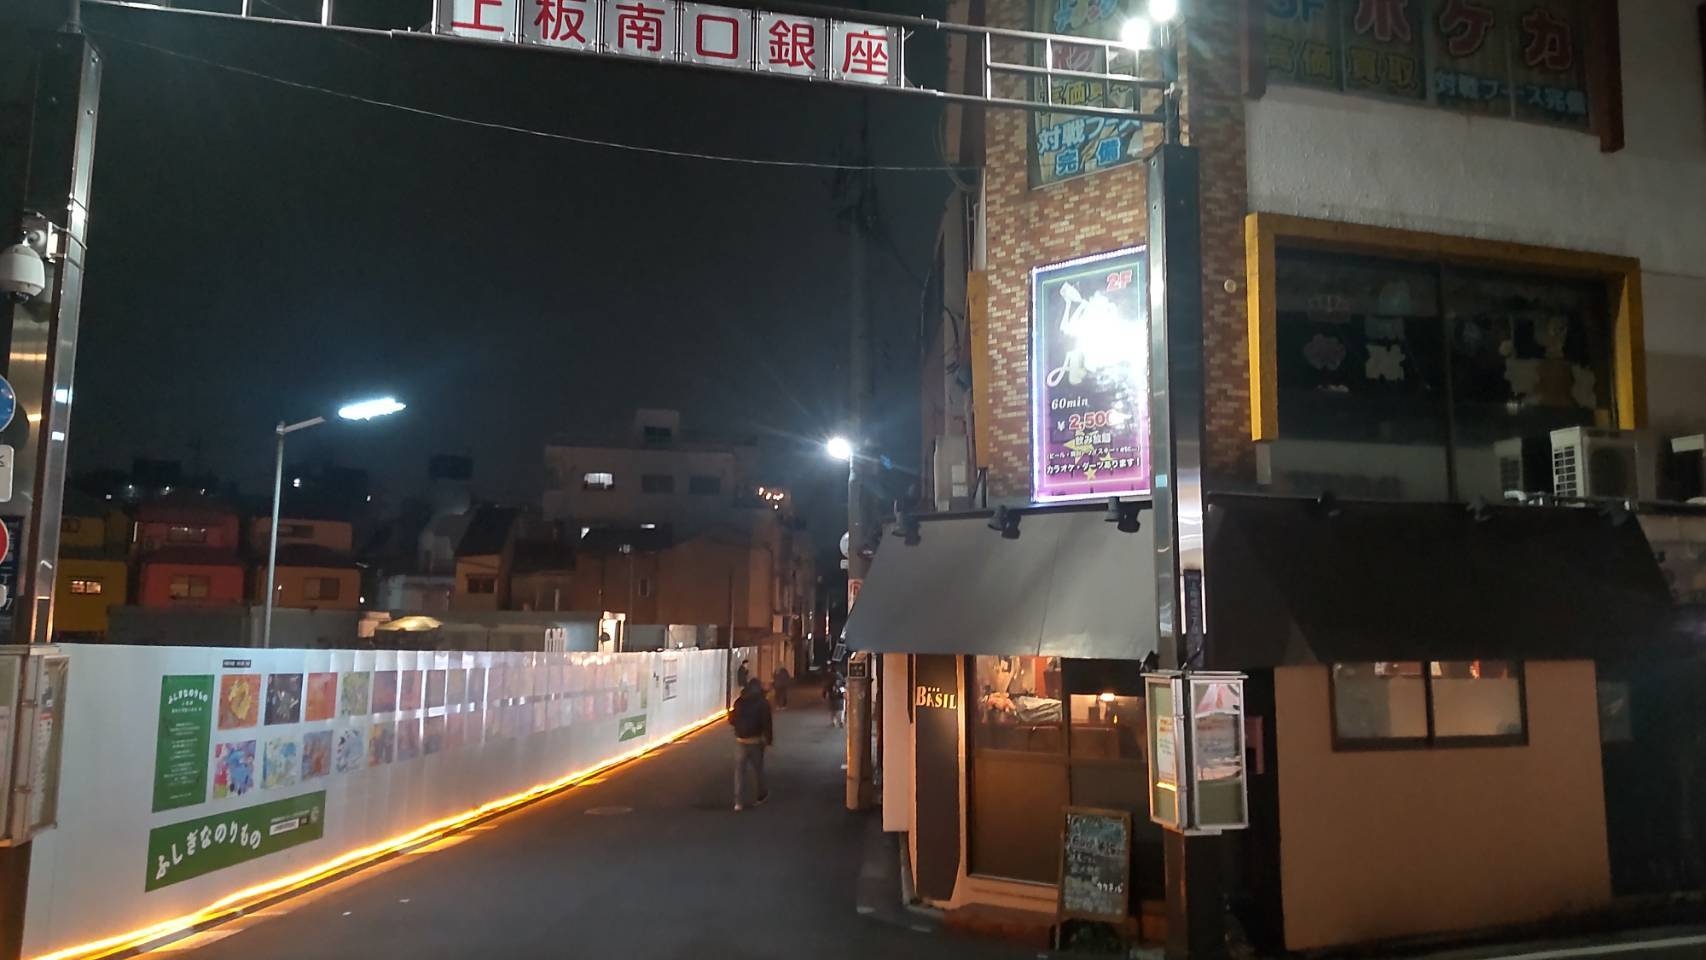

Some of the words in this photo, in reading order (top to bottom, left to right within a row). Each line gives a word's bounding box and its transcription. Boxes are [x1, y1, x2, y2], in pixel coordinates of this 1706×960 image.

[451, 0, 889, 77] 上板南口銀座
[1106, 270, 1133, 292] 2F
[156, 820, 261, 880] ふしぎなのりもの
